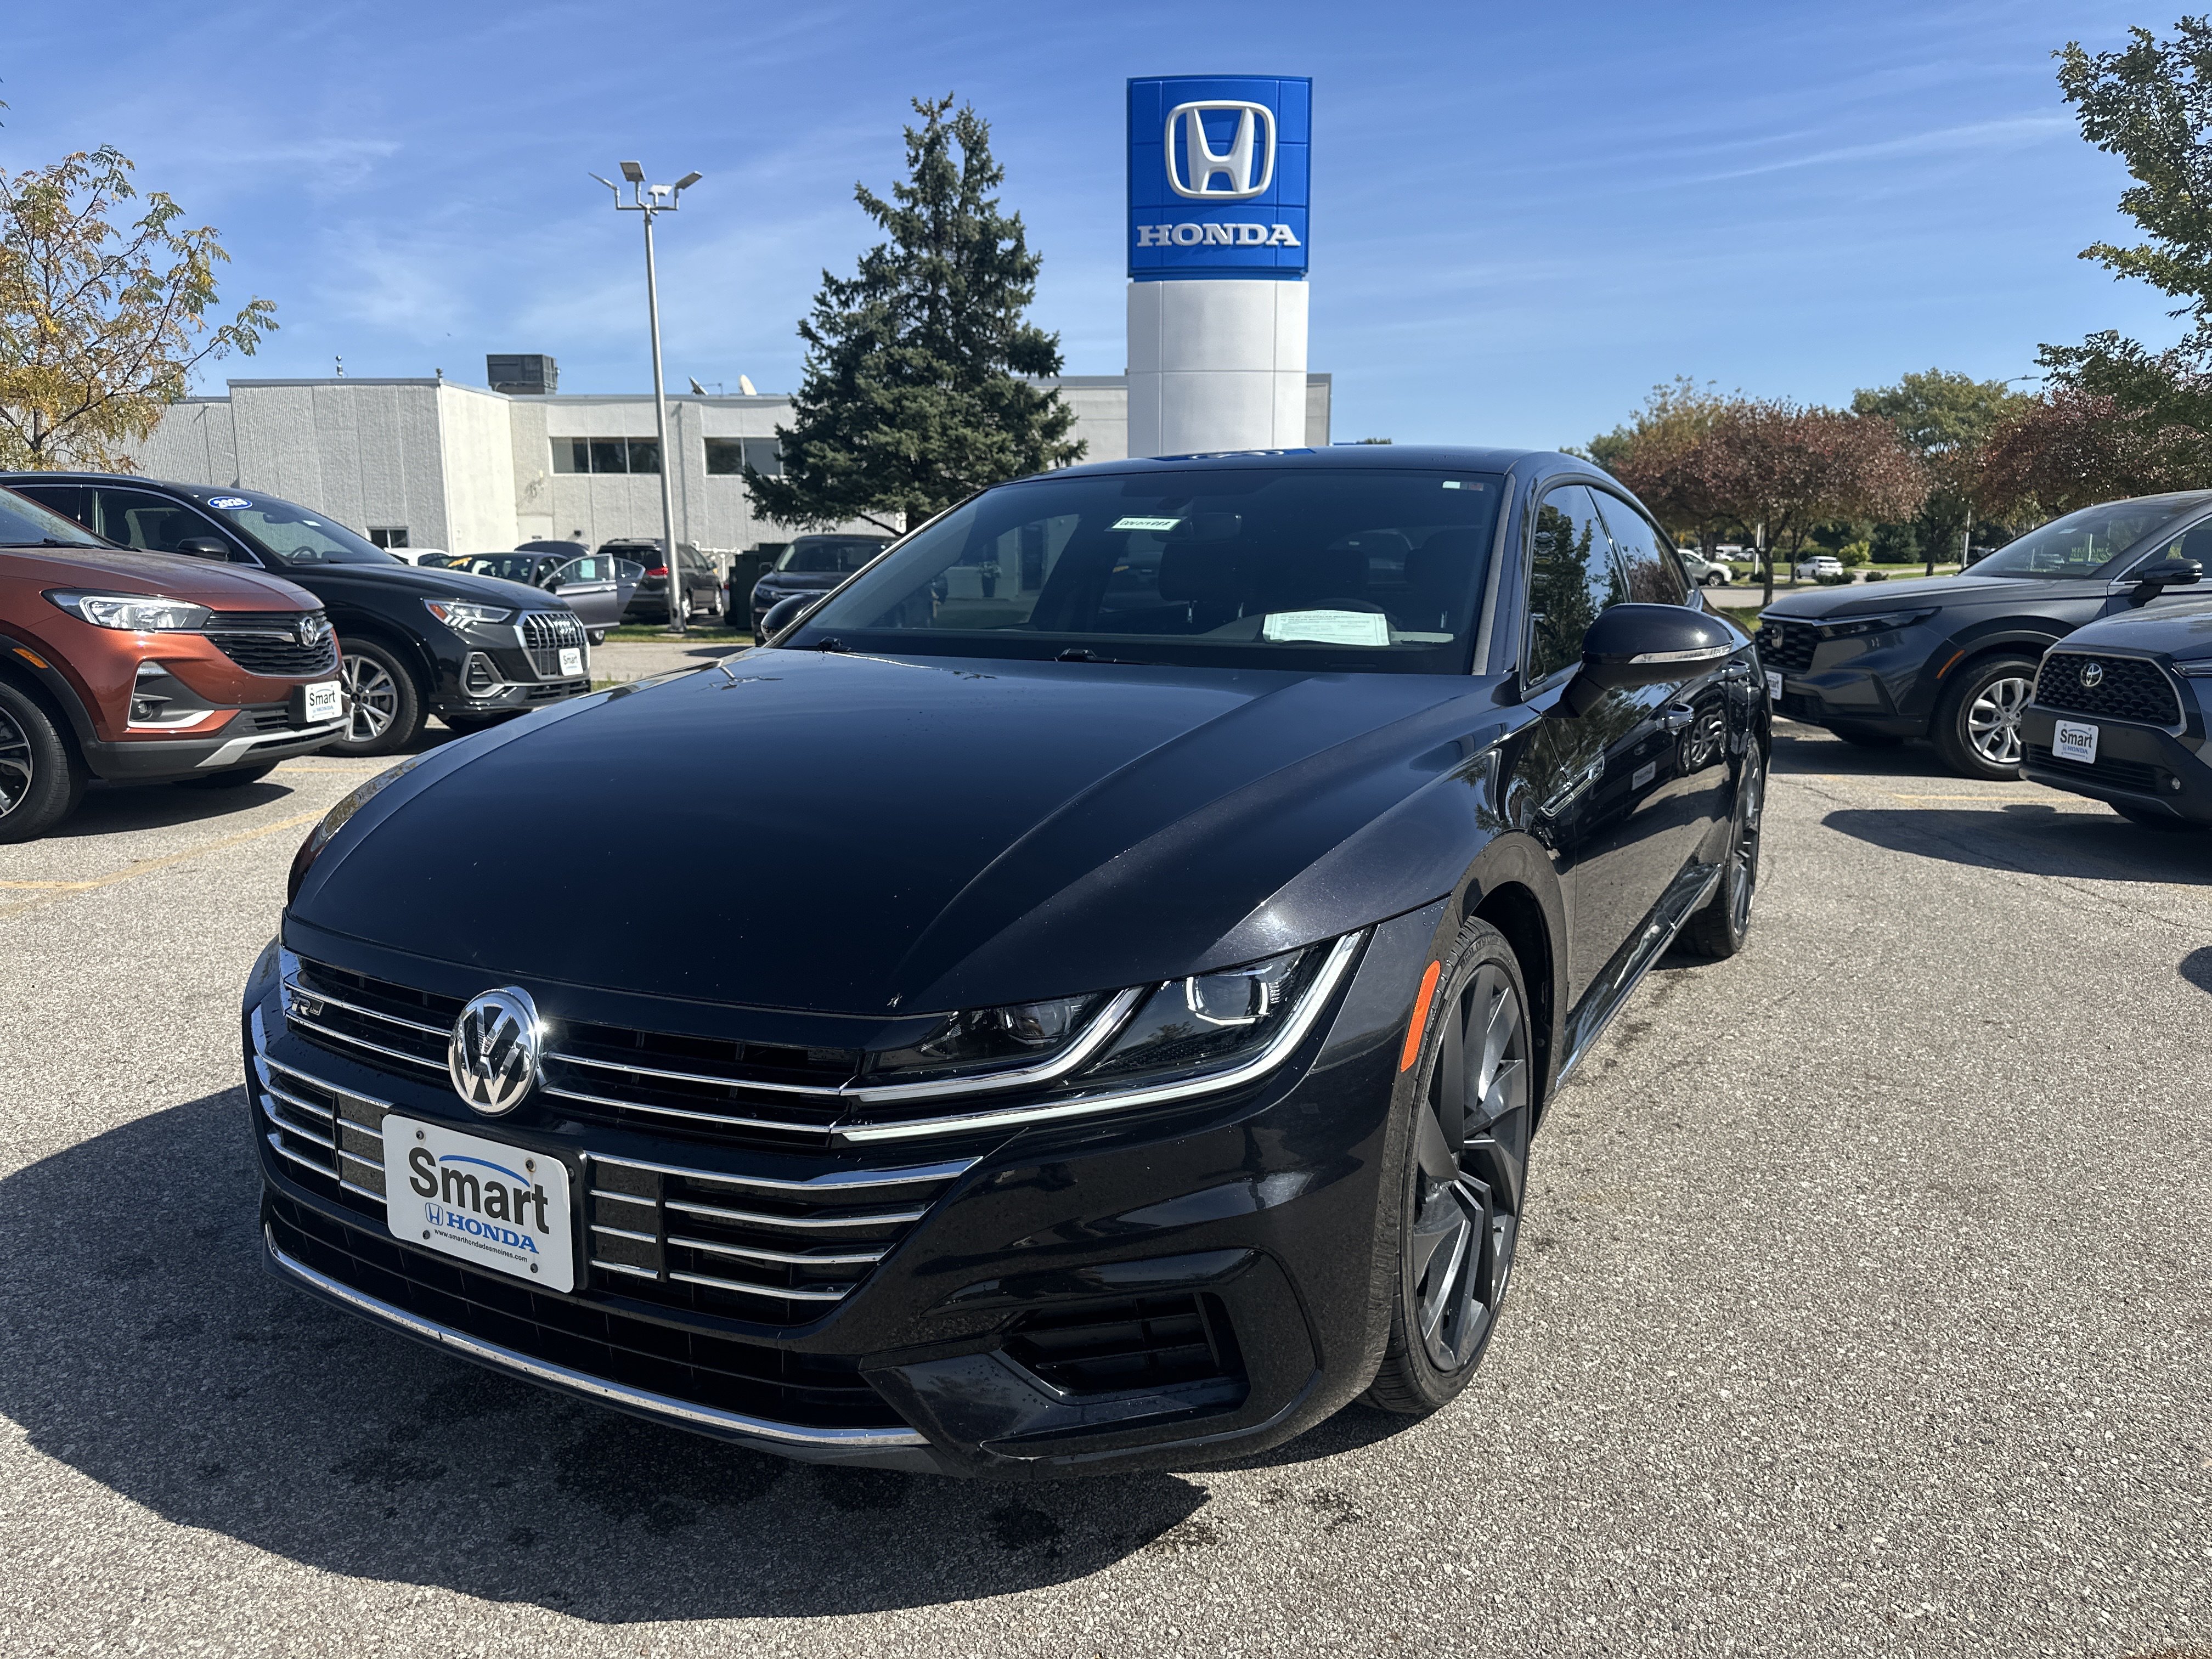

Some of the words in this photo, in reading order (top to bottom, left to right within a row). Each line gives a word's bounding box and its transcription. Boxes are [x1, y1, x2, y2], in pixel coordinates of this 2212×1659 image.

[1137, 223, 1301, 247] HONDA
[213, 498, 248, 508] 2025
[309, 691, 335, 706] Smart
[2060, 729, 2092, 748] Smart
[2067, 746, 2088, 755] HONDA
[409, 1147, 549, 1234] Smart
[446, 1211, 539, 1254] HONDA
[434, 1228, 528, 1263] www.smarthondadesmoines.com
